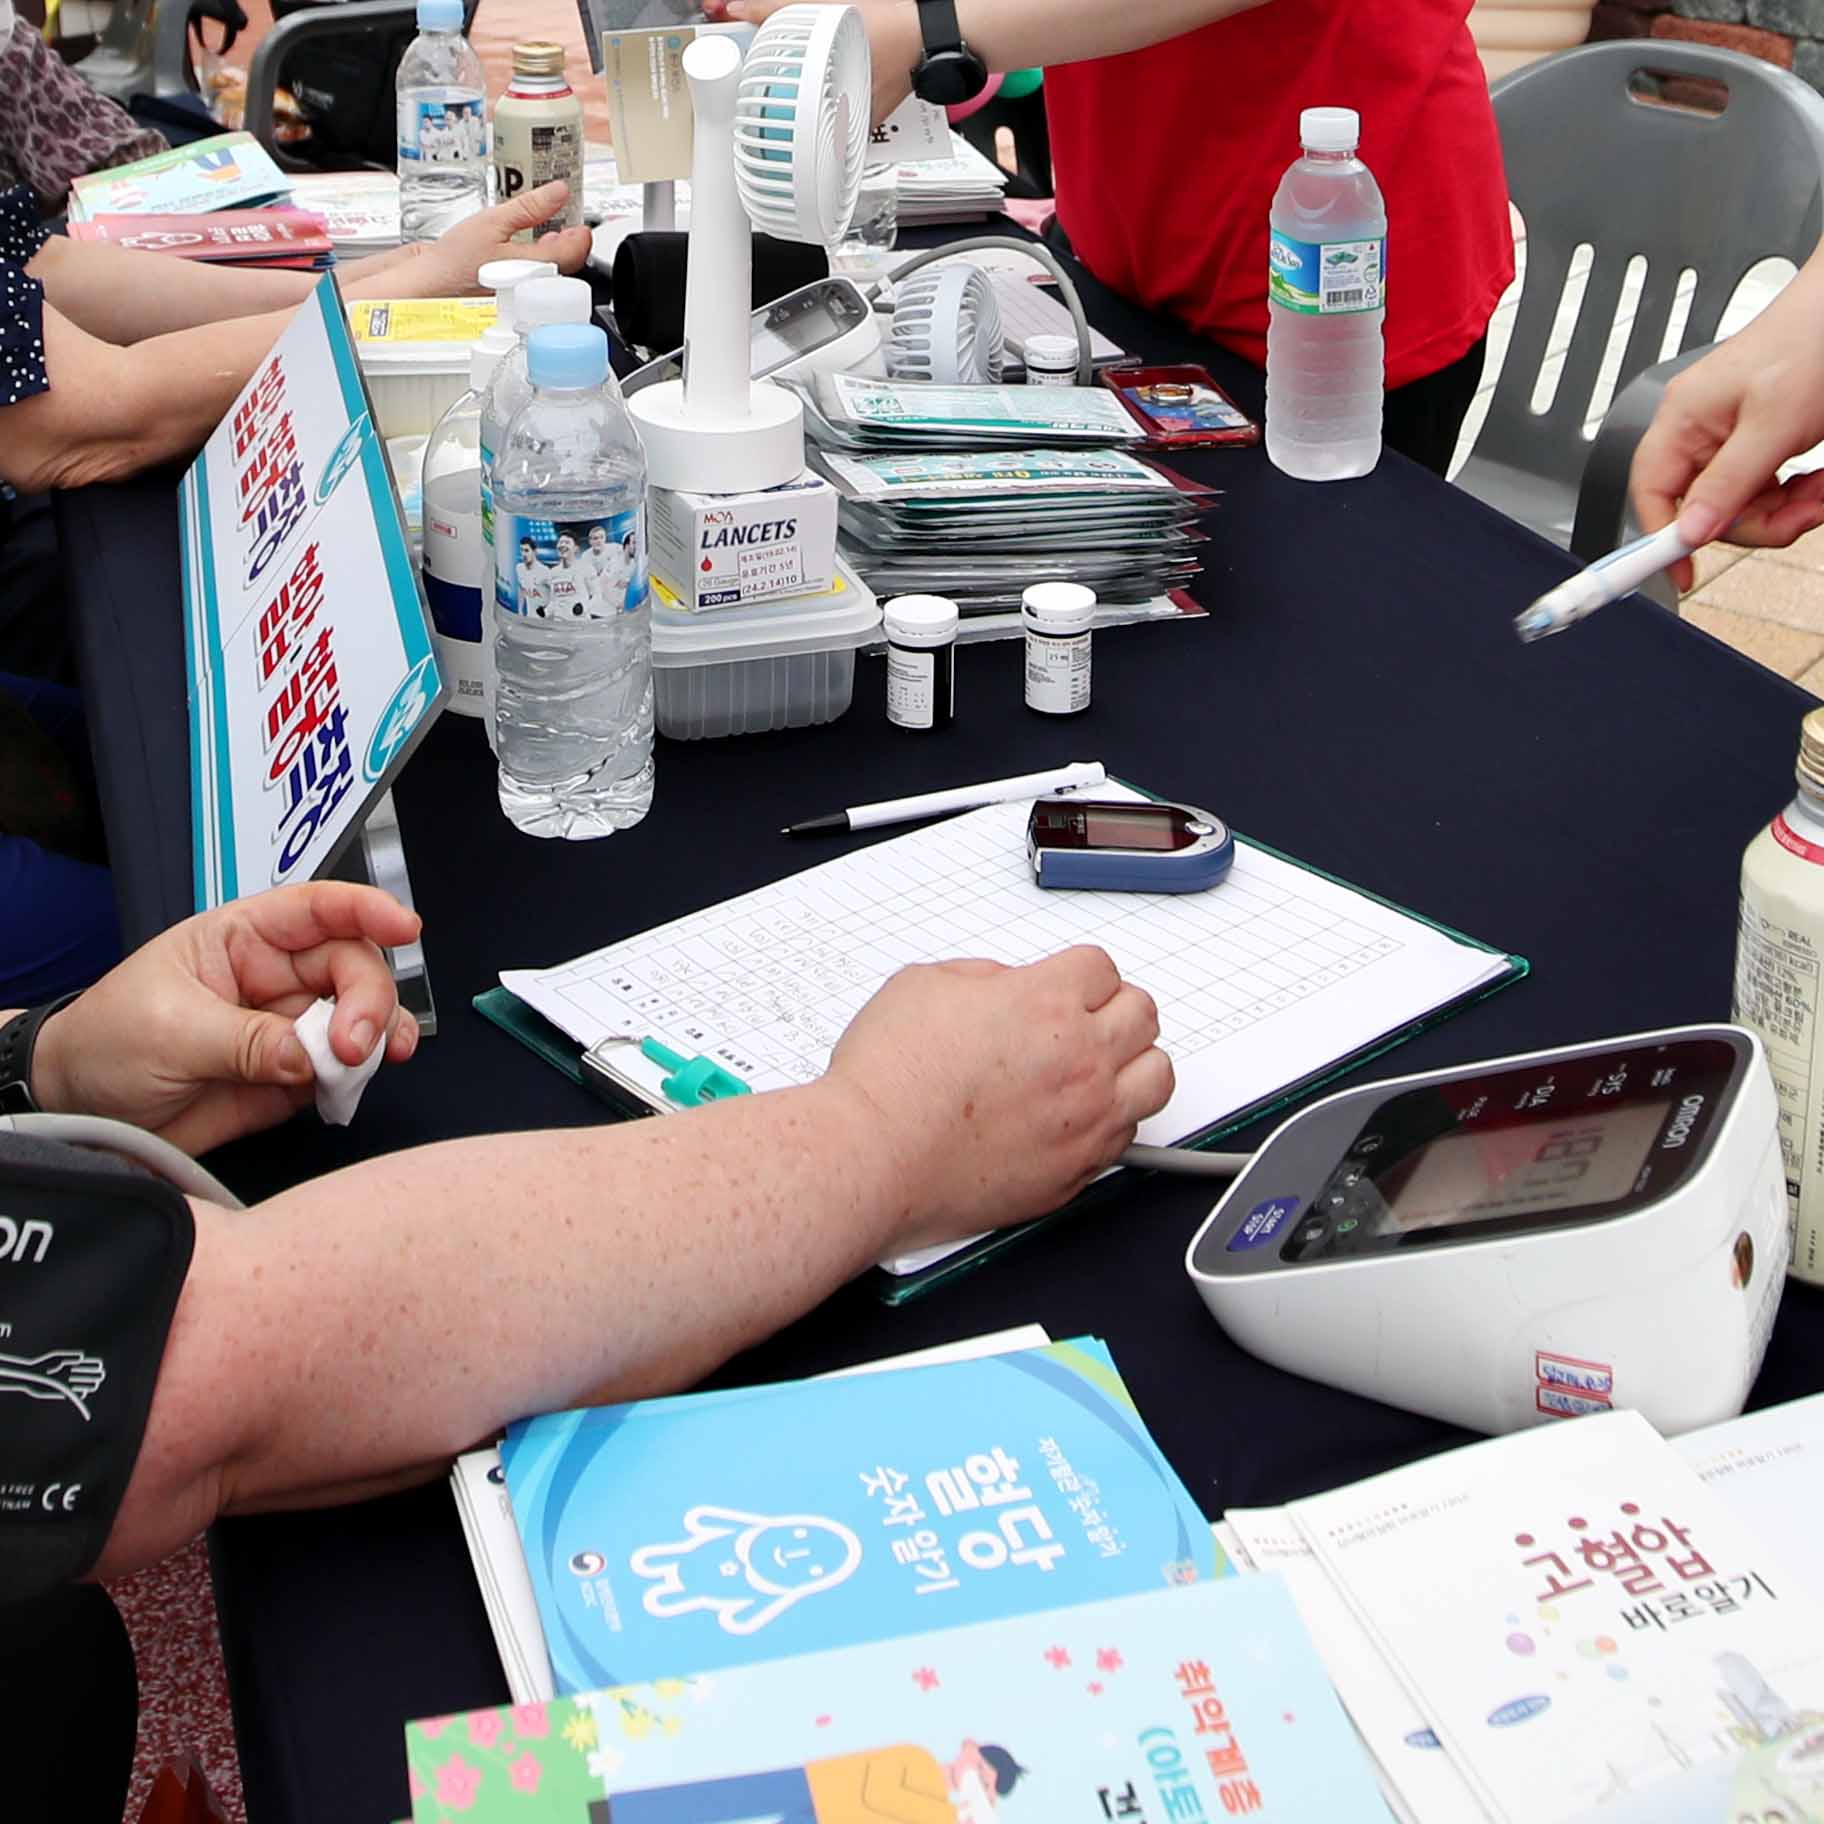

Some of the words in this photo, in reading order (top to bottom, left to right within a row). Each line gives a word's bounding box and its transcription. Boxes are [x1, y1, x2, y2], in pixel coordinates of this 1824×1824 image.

[700, 517, 798, 550] LANCETS
[1662, 1093, 1705, 1150] OMRON
[858, 1464, 927, 1527] 숫자
[925, 1445, 1066, 1573] 혈당
[890, 1528, 961, 1596] 알기
[1522, 1516, 1716, 1602] 고혈압
[1621, 1570, 1777, 1632] 바로알기
[1174, 1659, 1262, 1816] 취약계층
[1096, 1779, 1148, 1824] 건
[1137, 1726, 1212, 1824] (아토
